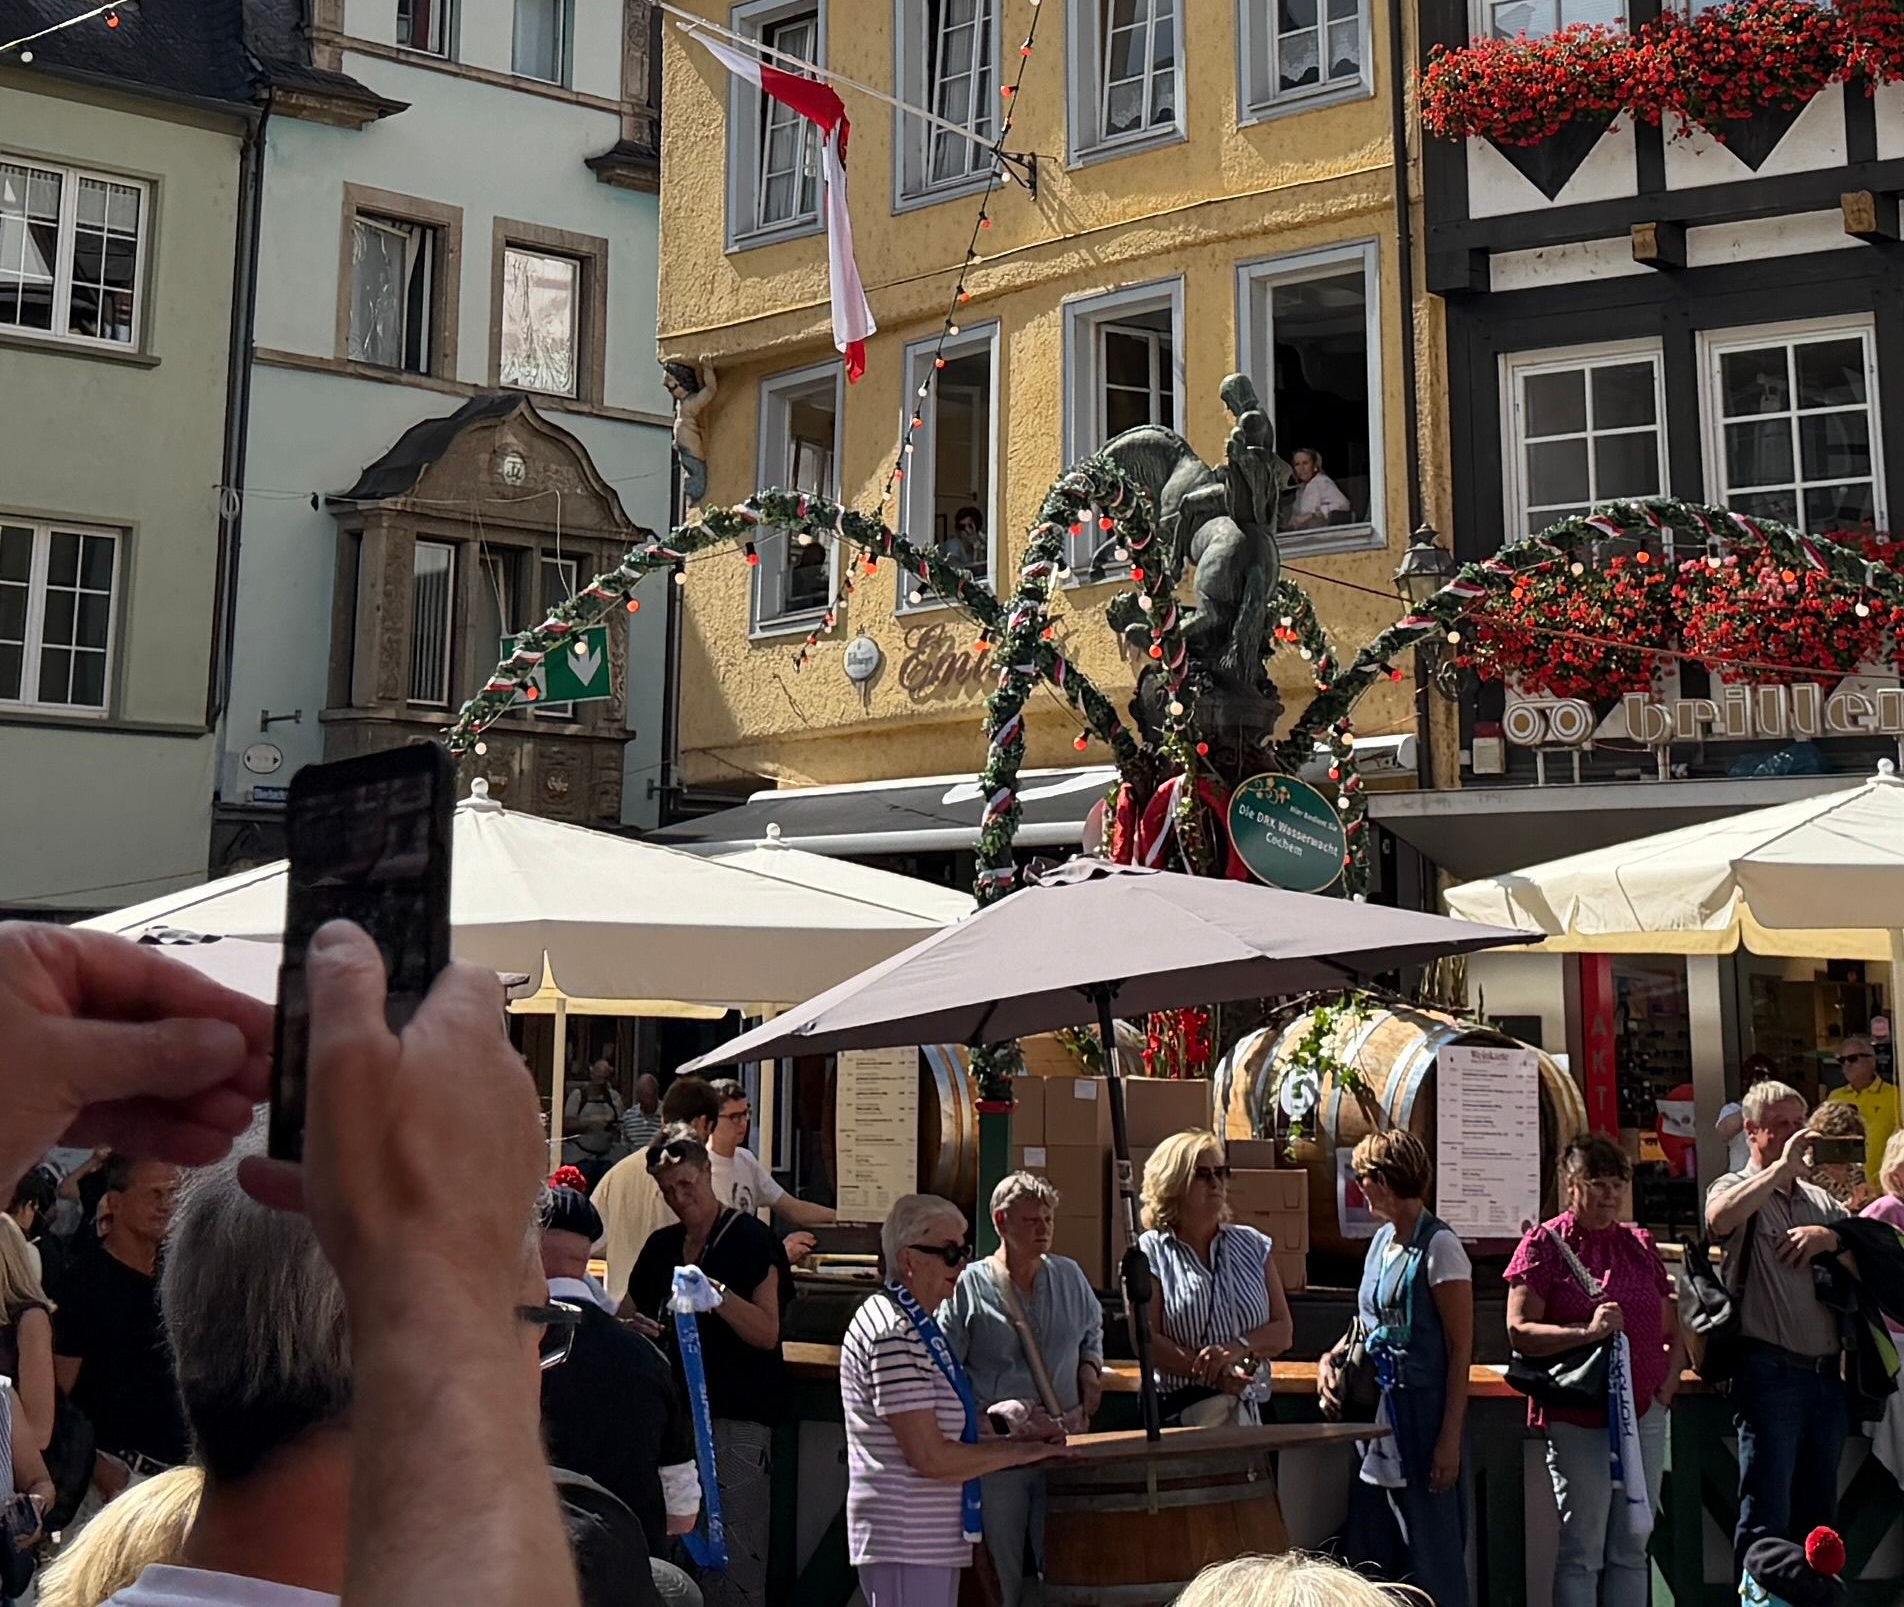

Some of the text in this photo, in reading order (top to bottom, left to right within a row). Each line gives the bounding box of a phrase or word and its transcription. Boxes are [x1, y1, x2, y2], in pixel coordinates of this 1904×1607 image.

[1238, 803, 1339, 857] Die DRK Wasserwacht
[1265, 831, 1303, 857] Cochem
